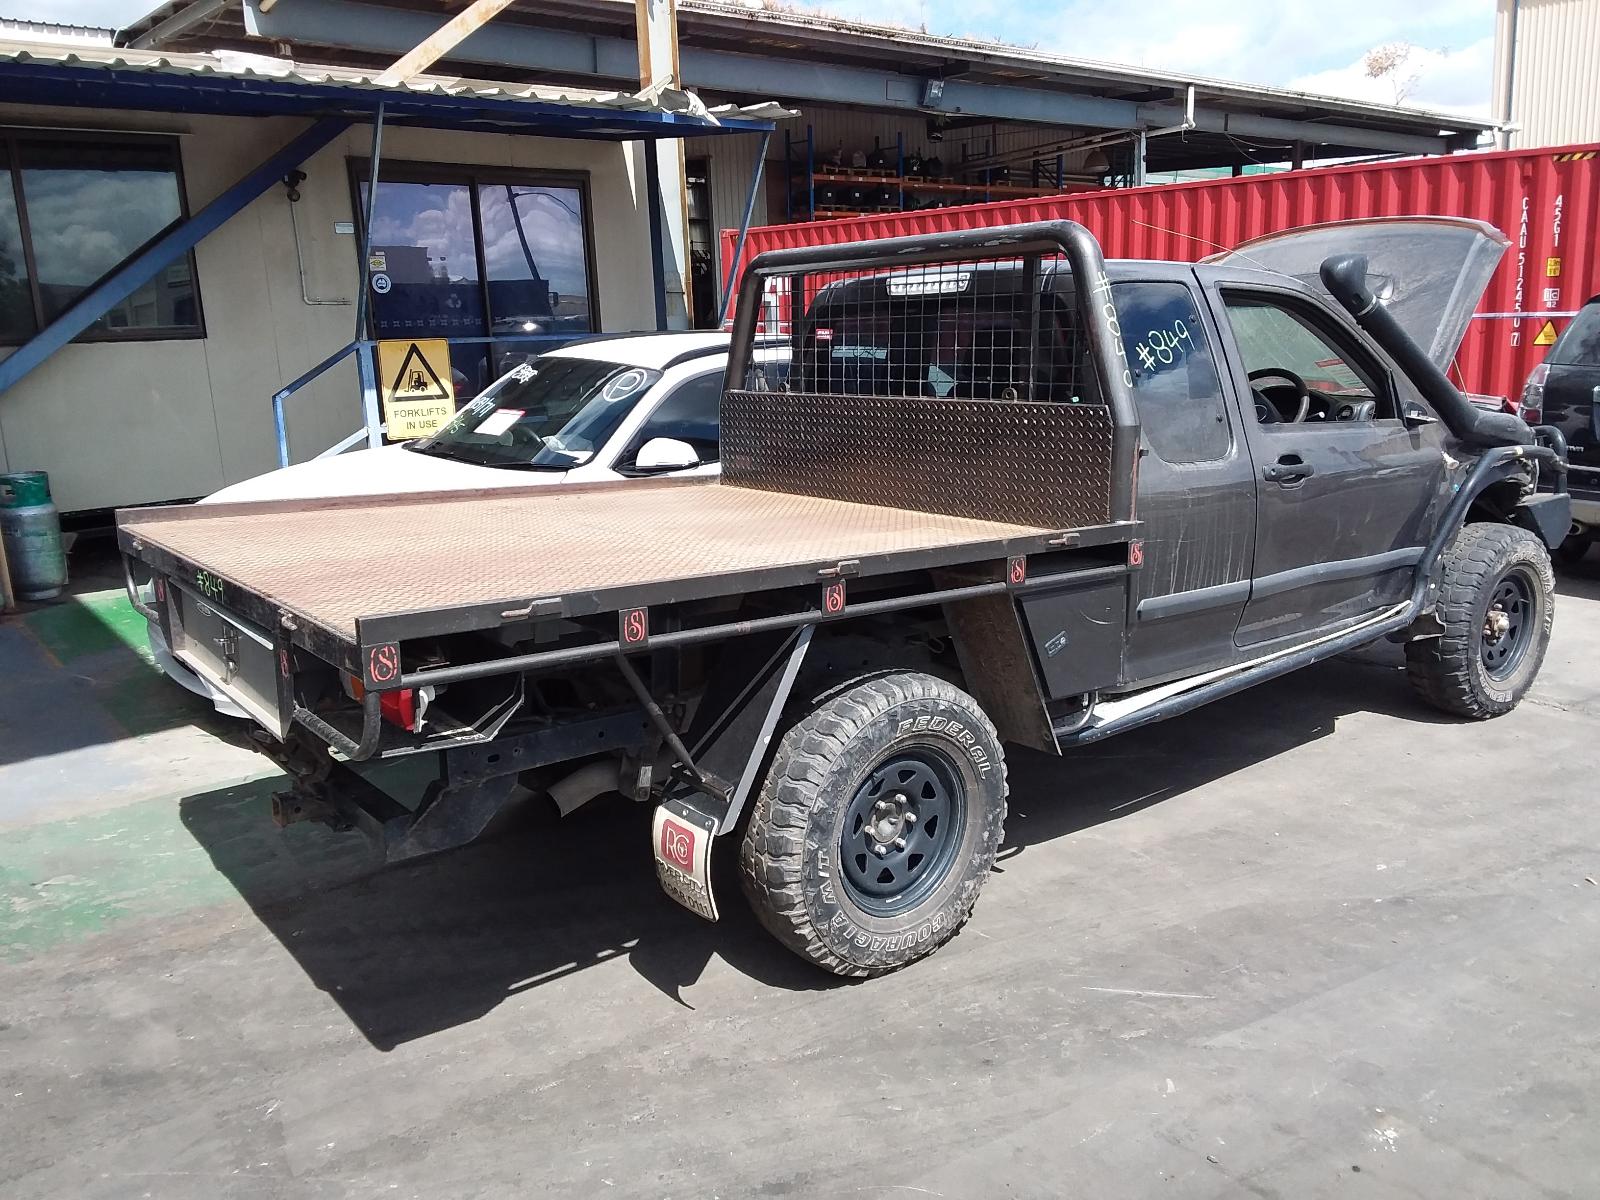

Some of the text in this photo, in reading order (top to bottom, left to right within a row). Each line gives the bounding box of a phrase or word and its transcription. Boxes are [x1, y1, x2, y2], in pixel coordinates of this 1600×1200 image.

[1519, 197, 1529, 249] CAAU
[1552, 194, 1563, 247] 45G1
[1135, 319, 1196, 372] #849
[393, 407, 447, 419] FORKLIFTS
[406, 421, 416, 430] IN
[419, 420, 438, 429] USE
[196, 569, 225, 605] #849
[896, 715, 992, 780] FEDERAL
[829, 911, 946, 952] COURAGIA
